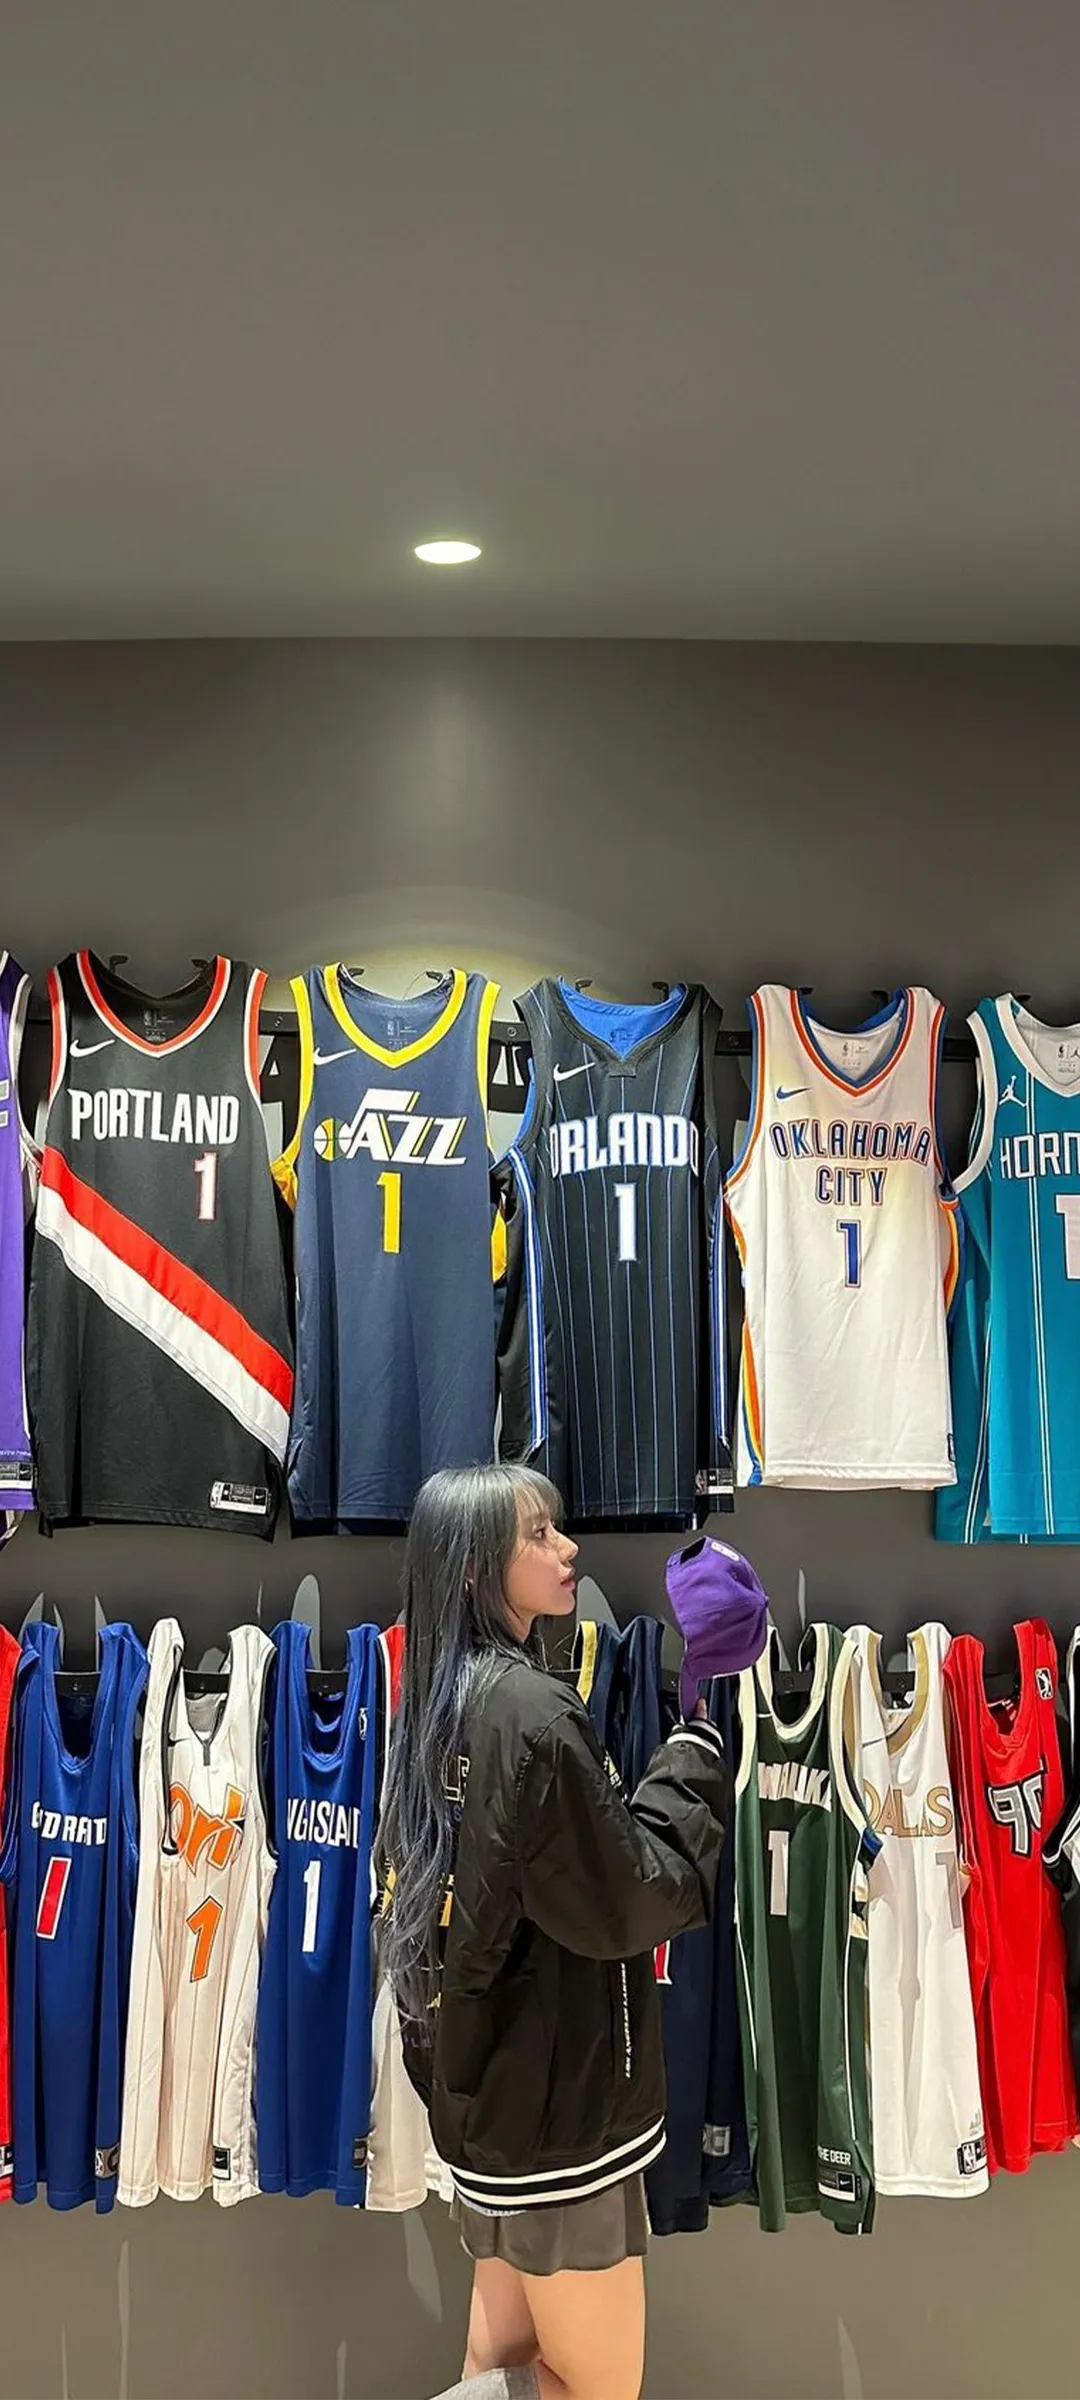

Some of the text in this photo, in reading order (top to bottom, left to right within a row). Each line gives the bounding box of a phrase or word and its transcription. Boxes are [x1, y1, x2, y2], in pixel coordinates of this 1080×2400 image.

[67, 1088, 240, 1145] PORTLAND
[314, 1088, 467, 1165] JAZZ
[549, 1111, 699, 1179] ORLANDO
[769, 1118, 934, 1167] OKLAHOMA
[193, 1151, 218, 1221] 1
[376, 1171, 402, 1254] 1
[613, 1182, 638, 1262] 1
[815, 1165, 888, 1206] CITY
[836, 1219, 862, 1288] 1
[303, 1859, 322, 1953] 1
[769, 1830, 790, 1916] 1
[936, 1851, 962, 1929] 1
[186, 1895, 223, 1983] 1
